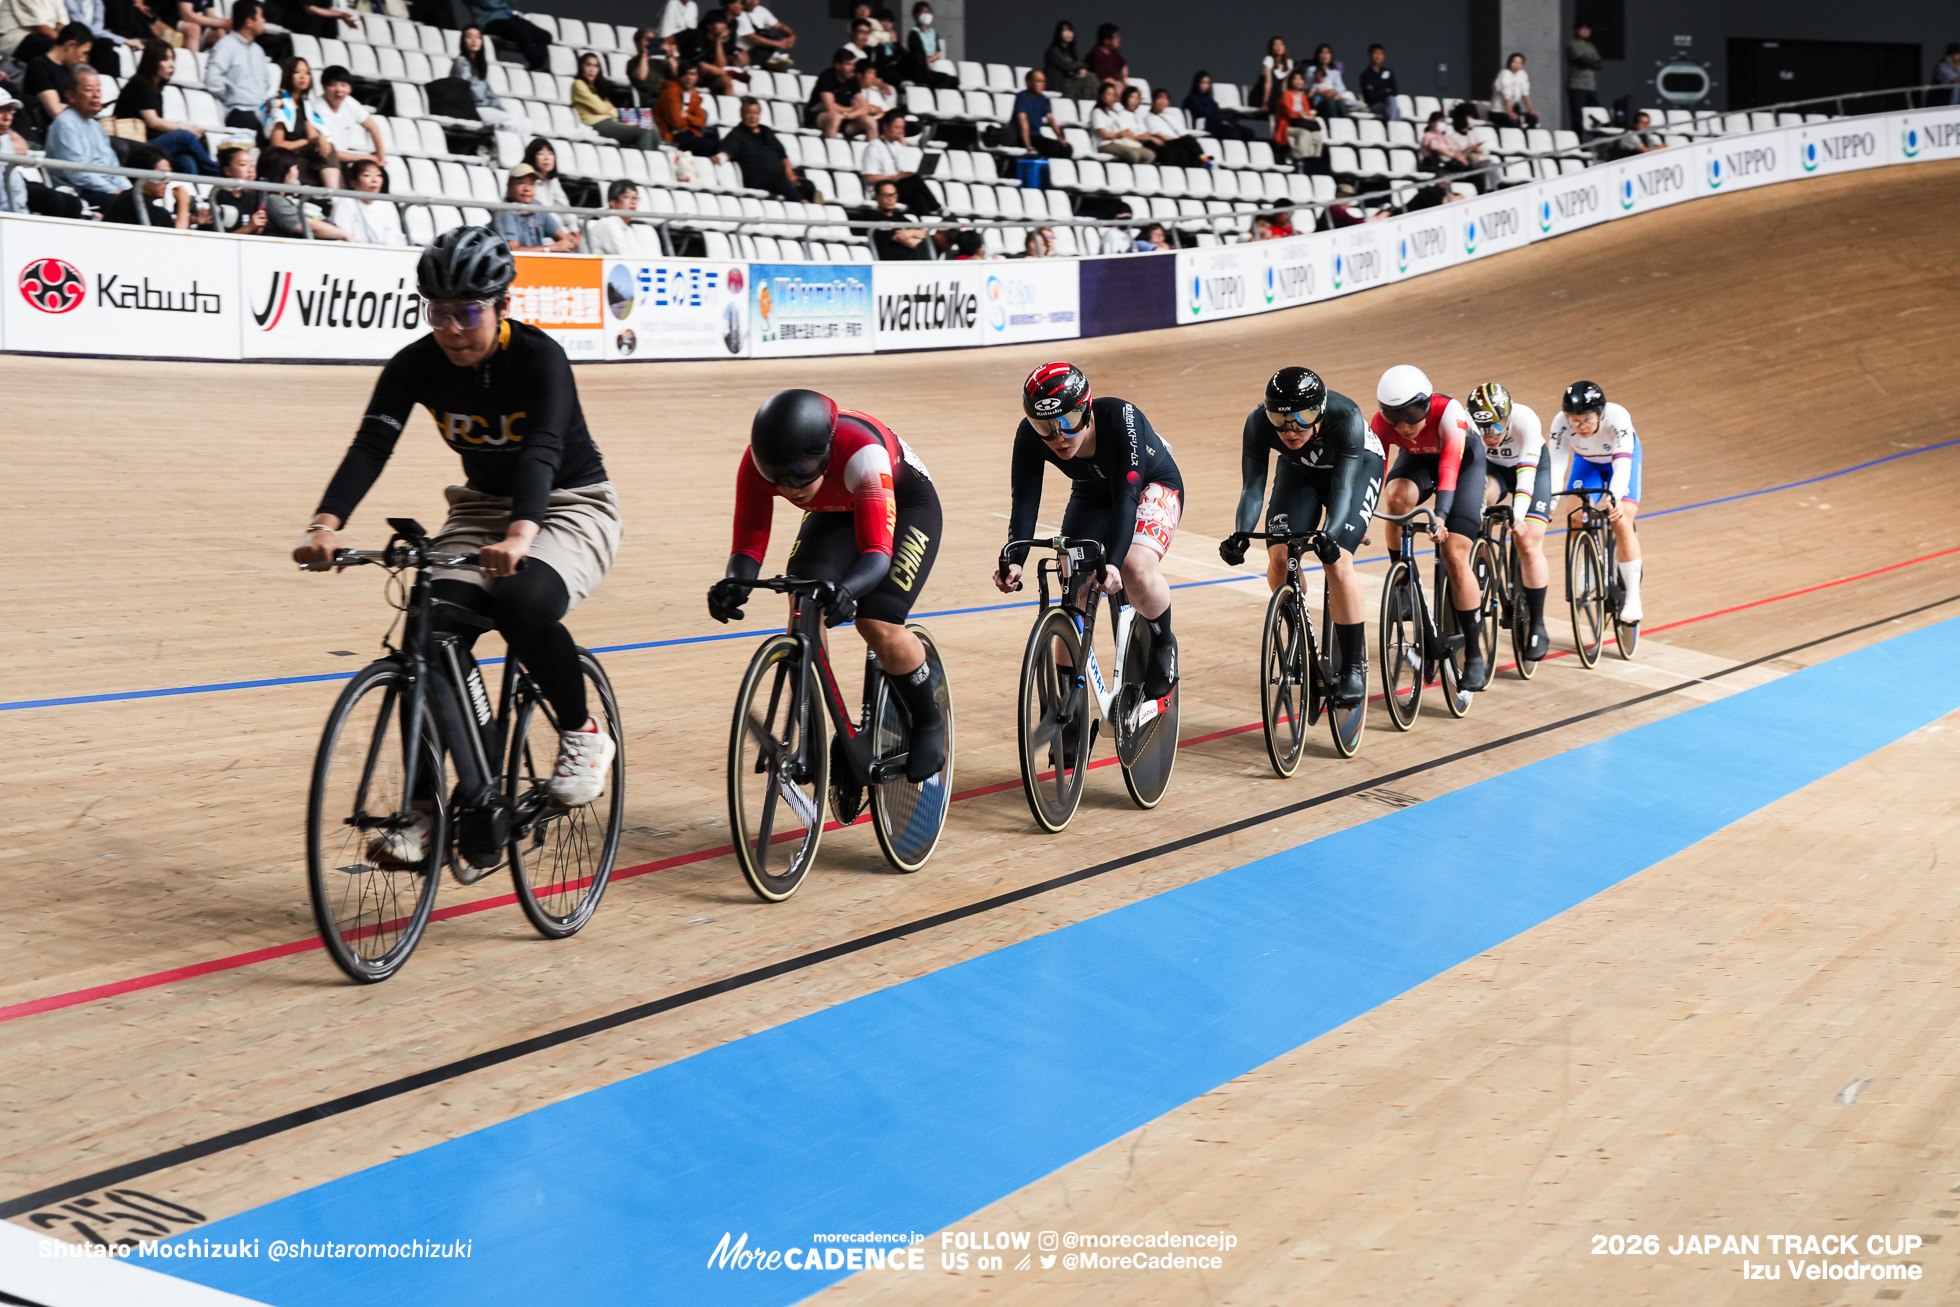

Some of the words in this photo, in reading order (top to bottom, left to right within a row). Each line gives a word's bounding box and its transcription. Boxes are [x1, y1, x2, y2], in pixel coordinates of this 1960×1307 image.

[1725, 147, 1776, 177] NIPPO
[1822, 132, 1875, 163] NIPPO
[1554, 185, 1598, 220] NIPPO
[1638, 165, 1684, 200] NIPPO
[1411, 226, 1447, 259] NIPPO
[1479, 207, 1519, 243] NIPPO
[97, 273, 221, 315] Kabuto
[296, 273, 421, 330] vittoria
[878, 280, 978, 331] wattbike
[1359, 476, 1381, 527] NZL
[890, 525, 930, 592] CHINA
[466, 667, 492, 727] YAMAHA
[28, 1188, 207, 1248] 250
